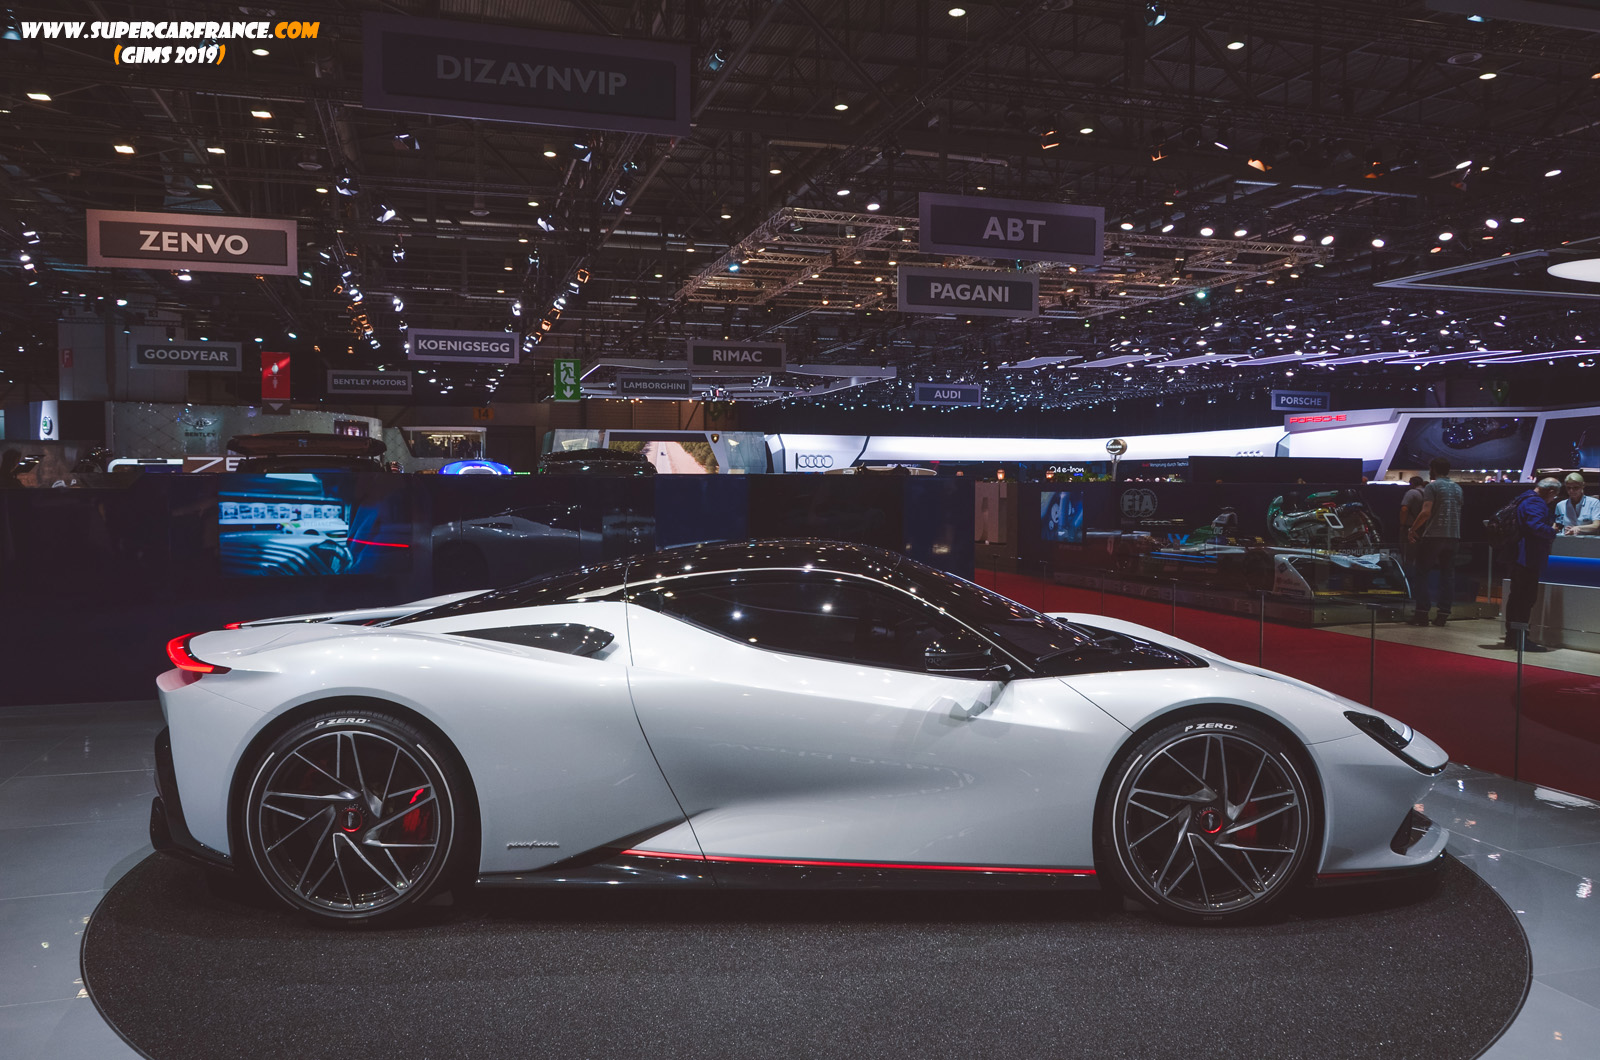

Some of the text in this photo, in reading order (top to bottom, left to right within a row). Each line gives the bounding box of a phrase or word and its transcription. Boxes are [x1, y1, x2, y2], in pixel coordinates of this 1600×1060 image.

[436, 54, 628, 97] DIZAYNVIP
[982, 216, 1047, 244] ABT
[139, 230, 250, 256] ZENVO
[930, 282, 1010, 303] PAGANI
[418, 339, 511, 354] KOENIGSEGG
[144, 348, 230, 363] GOODYEAR
[712, 349, 764, 364] RIMAC
[333, 377, 407, 388] BENTLEY MOTORS
[623, 381, 687, 391] LAMBORGHINI
[934, 389, 962, 400] AUDI
[1280, 396, 1322, 406] PORSCHE
[1289, 414, 1347, 424] PORSCHE
[327, 718, 367, 726] ZERO
[1195, 722, 1234, 730] ZERO
